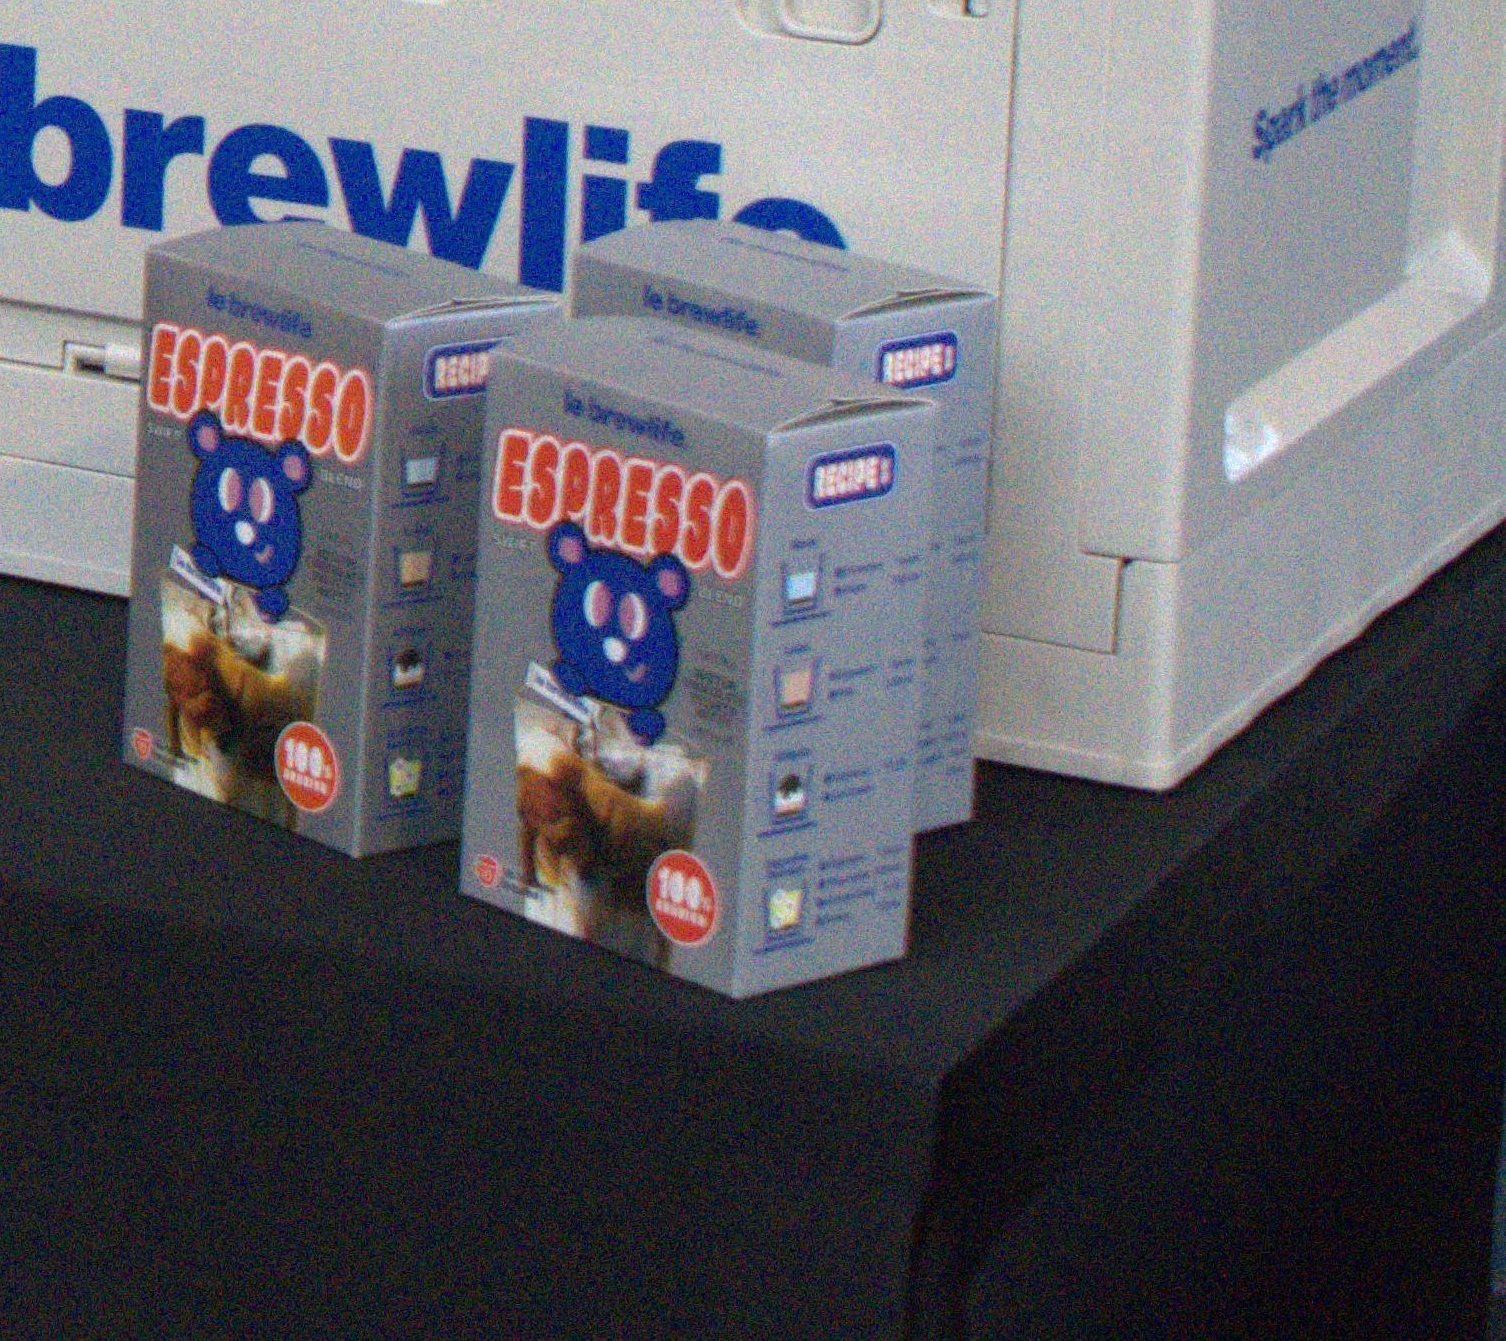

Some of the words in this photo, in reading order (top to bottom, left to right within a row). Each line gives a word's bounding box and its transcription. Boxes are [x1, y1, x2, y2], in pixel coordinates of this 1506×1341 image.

[642, 284, 663, 309] le
[146, 322, 371, 464] ESPRESSO
[563, 388, 583, 414] le
[492, 428, 753, 580] ESPRESSO
